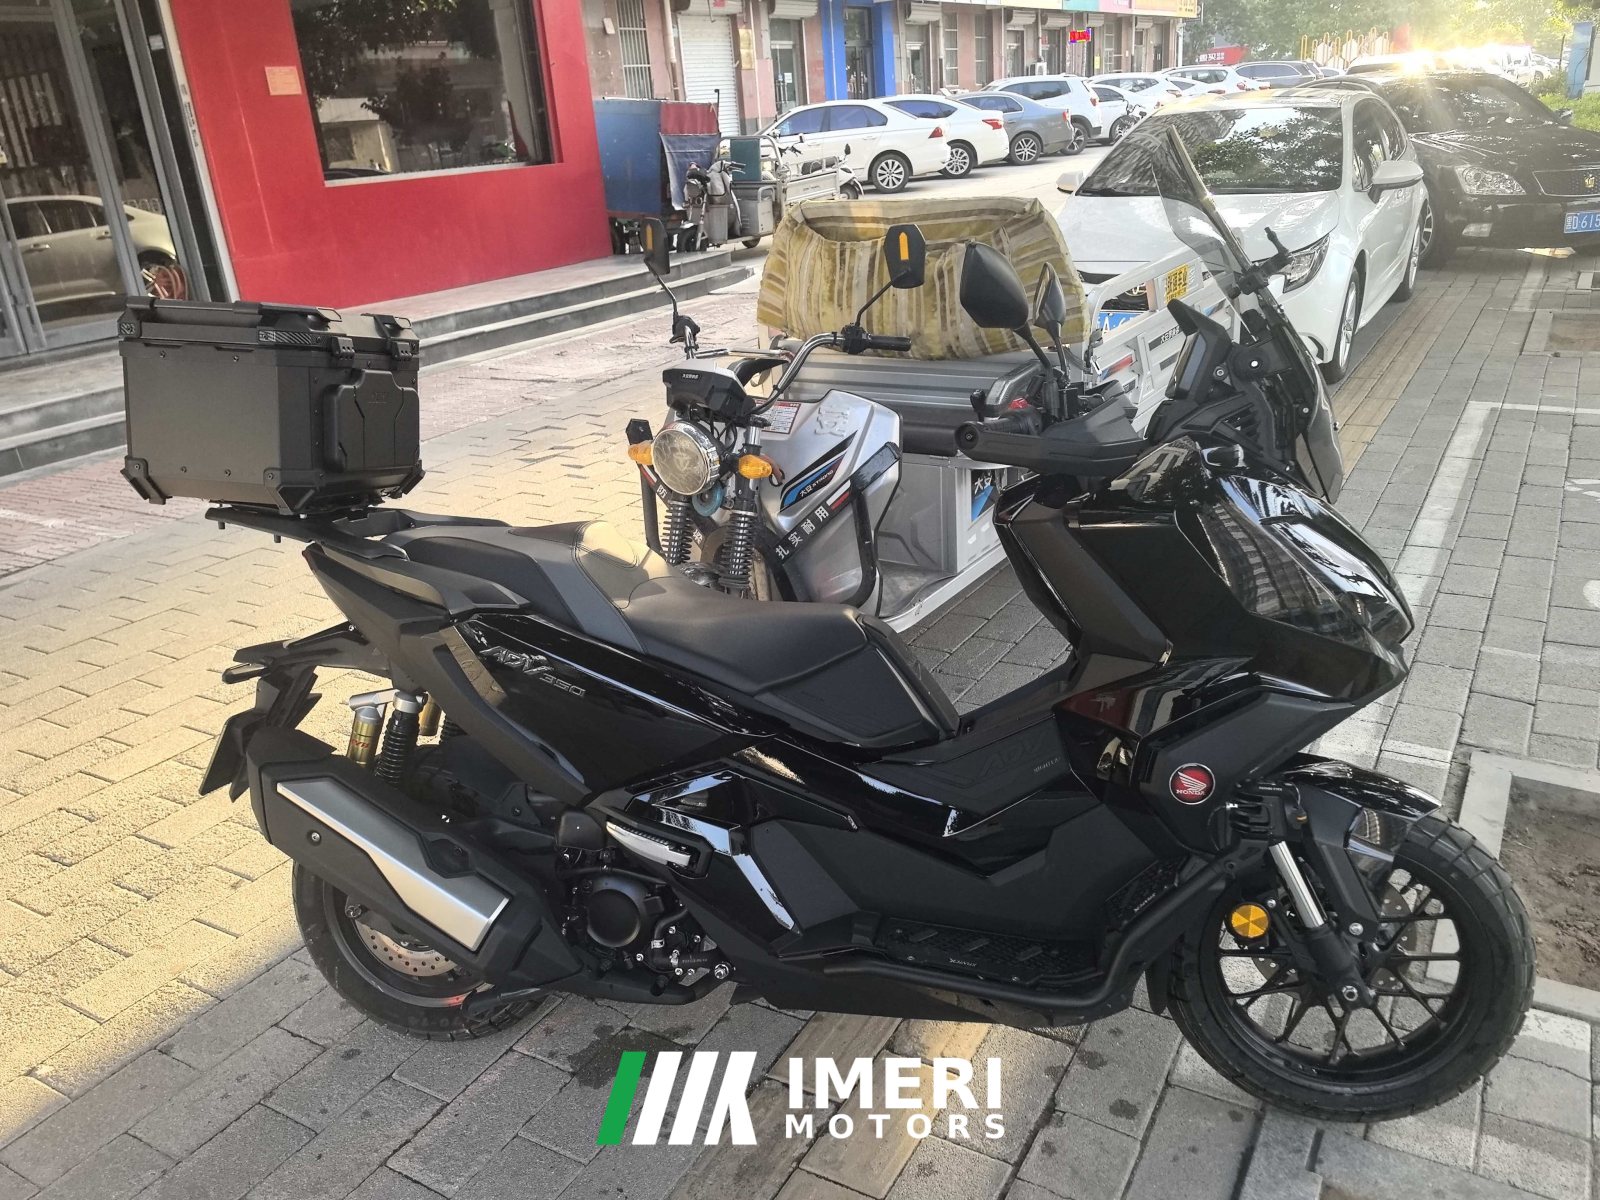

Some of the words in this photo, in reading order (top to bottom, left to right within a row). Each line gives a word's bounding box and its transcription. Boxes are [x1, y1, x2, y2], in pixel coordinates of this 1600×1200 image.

[775, 505, 829, 559] 扎实耐用
[539, 672, 587, 698] 350
[1176, 788, 1205, 797] HONDA
